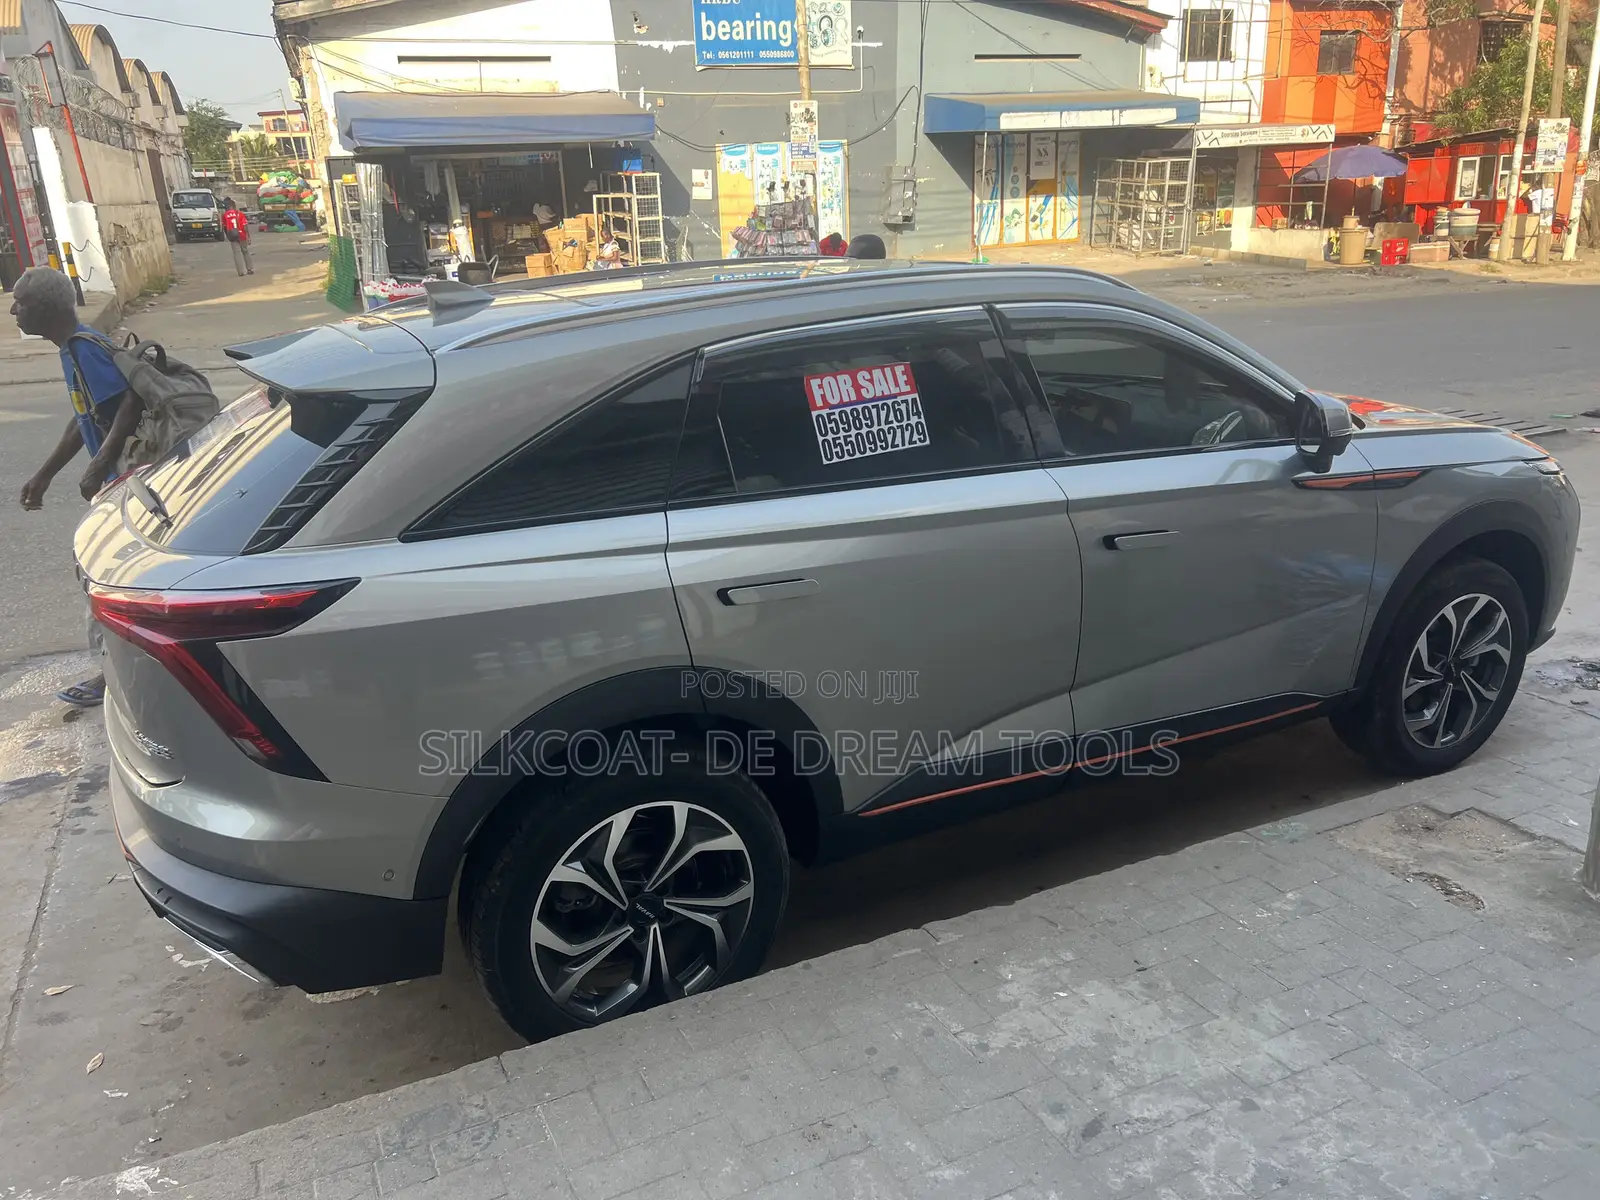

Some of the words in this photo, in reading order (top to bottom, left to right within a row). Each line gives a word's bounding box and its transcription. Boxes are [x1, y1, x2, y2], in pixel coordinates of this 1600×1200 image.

[700, 12, 792, 47] bearing
[702, 51, 716, 60] Tel:
[718, 50, 754, 59] 0561201111
[1240, 129, 1258, 137] Services
[810, 374, 857, 407] FOR
[856, 365, 911, 399] SALE
[815, 397, 922, 438] 0598972674
[821, 420, 928, 463] 0550992729
